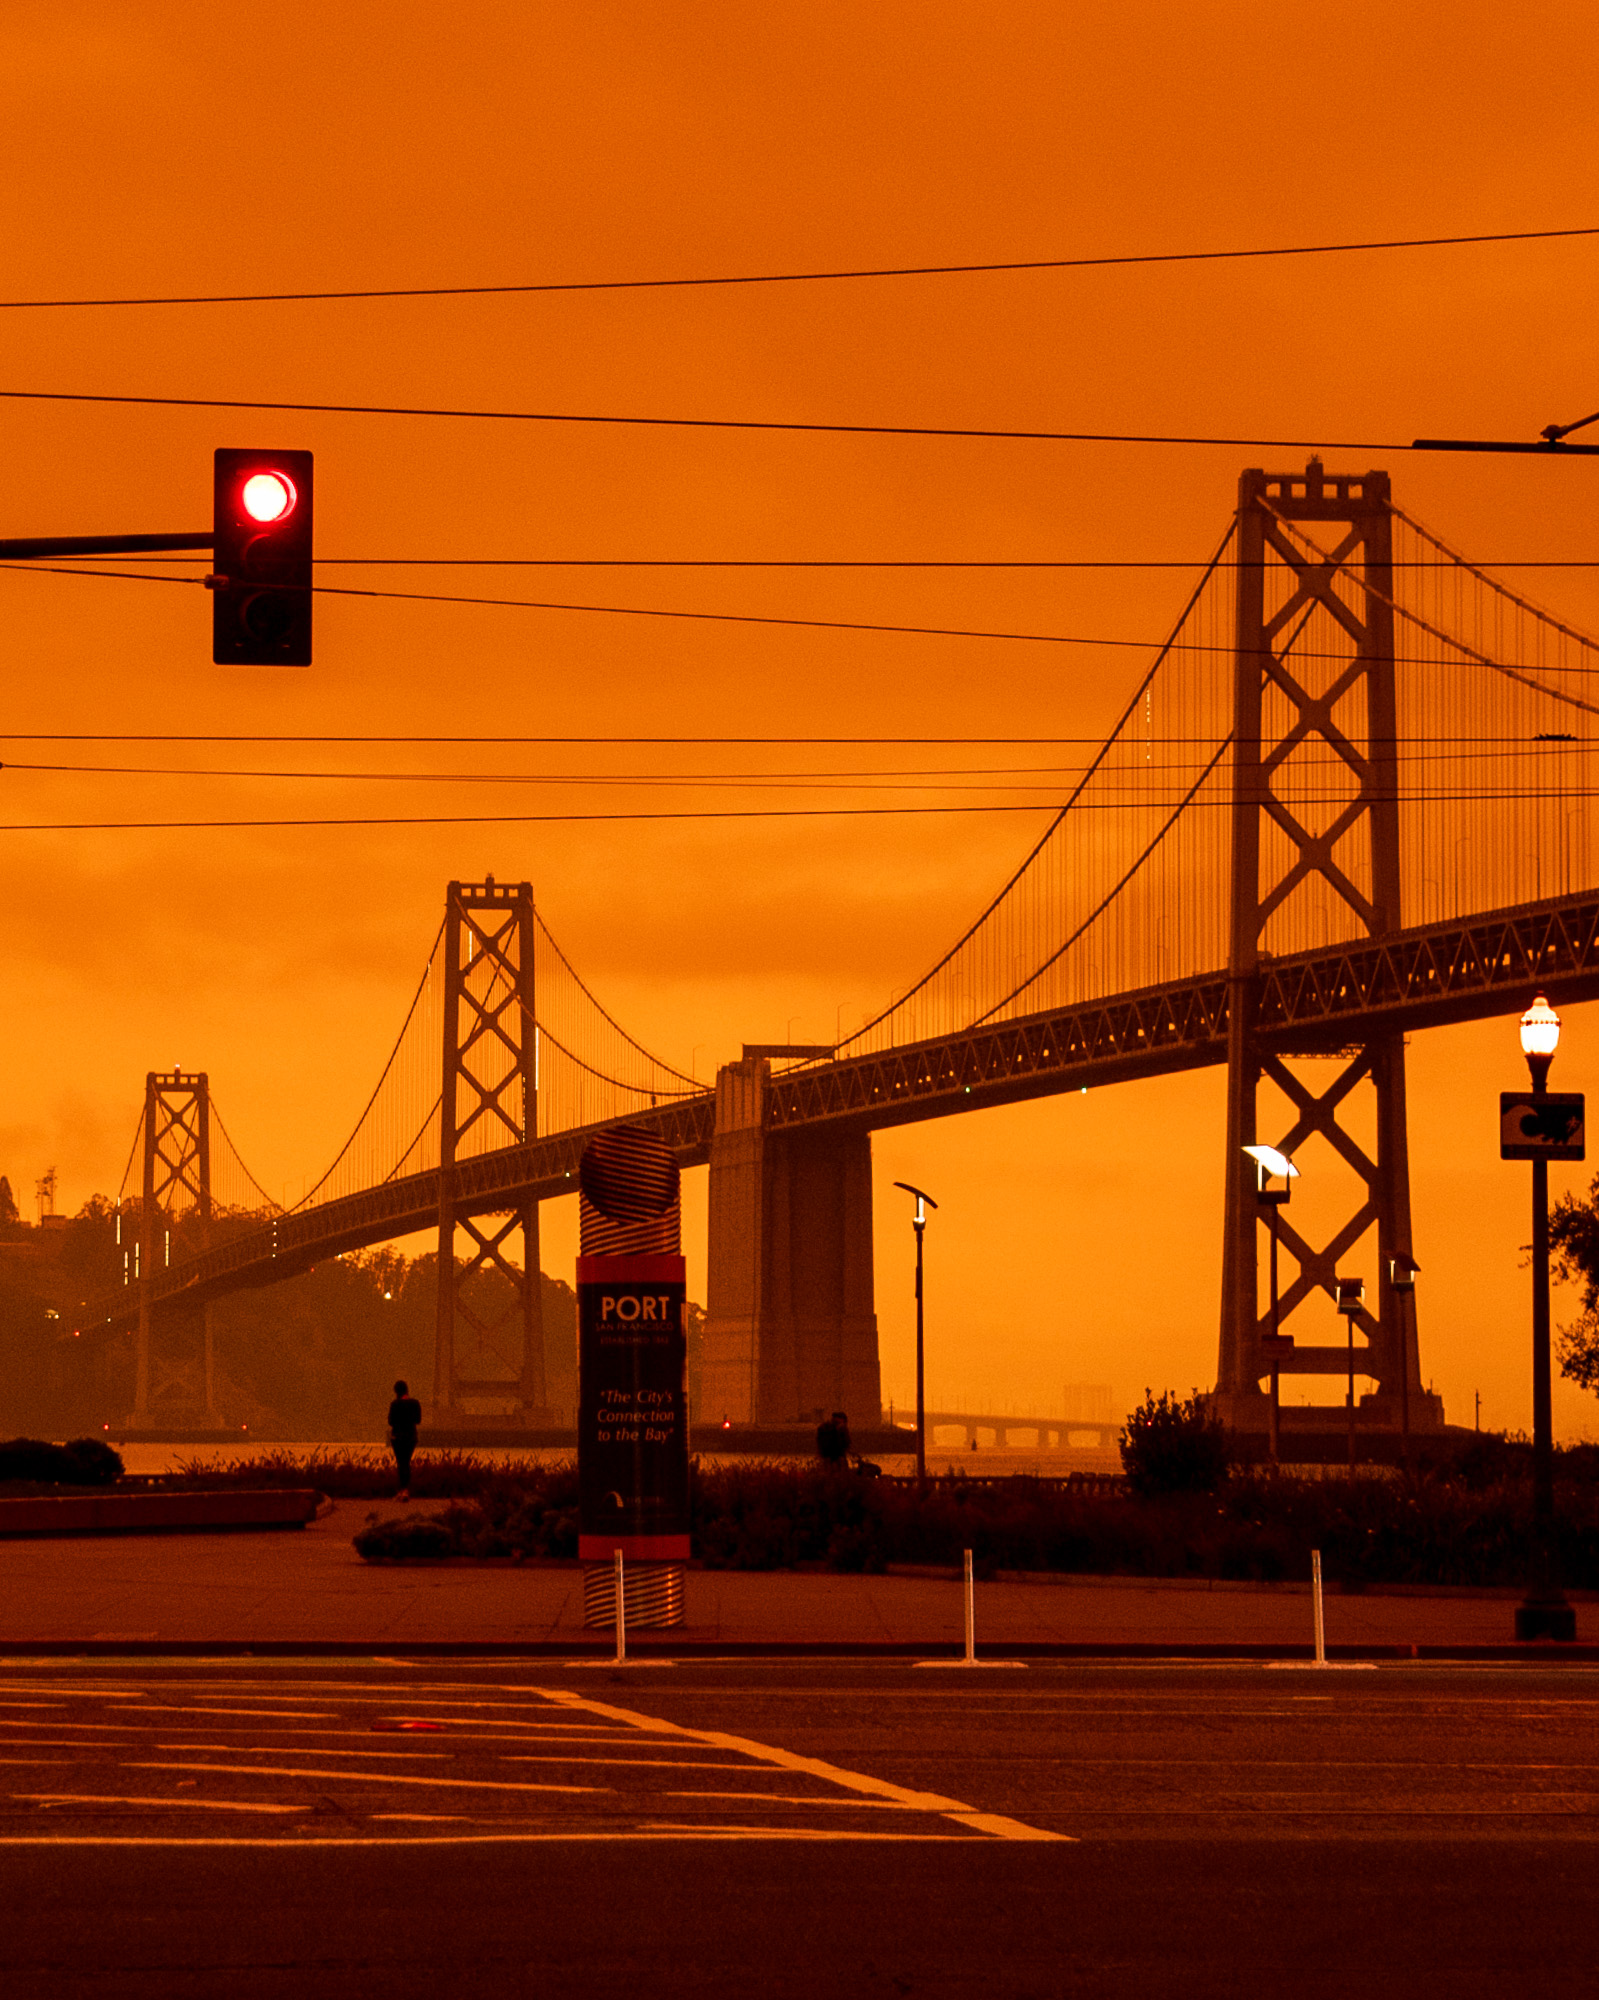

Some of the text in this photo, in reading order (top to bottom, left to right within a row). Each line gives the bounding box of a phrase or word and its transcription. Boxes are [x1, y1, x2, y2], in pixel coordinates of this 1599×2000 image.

[602, 1296, 669, 1321] PORT
[595, 1322, 674, 1331] SAN FRANCISCO
[637, 1389, 672, 1406] City's
[597, 1408, 674, 1422] Connection
[598, 1429, 611, 1441] to
[616, 1427, 639, 1441] the
